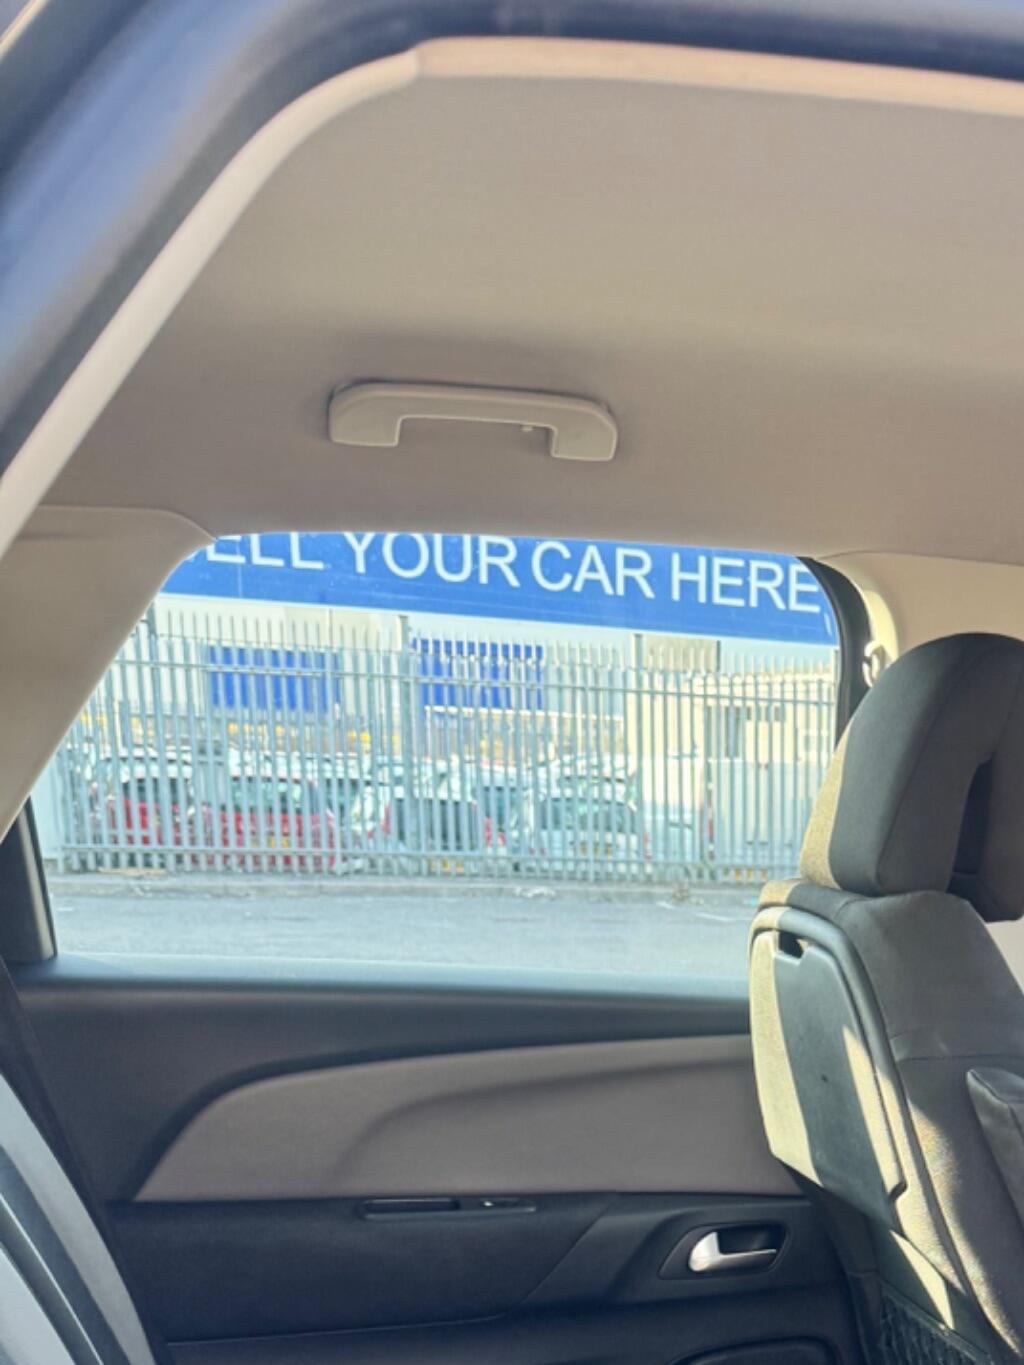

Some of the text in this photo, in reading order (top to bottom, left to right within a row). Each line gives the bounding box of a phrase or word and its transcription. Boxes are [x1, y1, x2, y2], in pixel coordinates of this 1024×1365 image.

[187, 532, 821, 613] ELL YOUR CAR HERE
